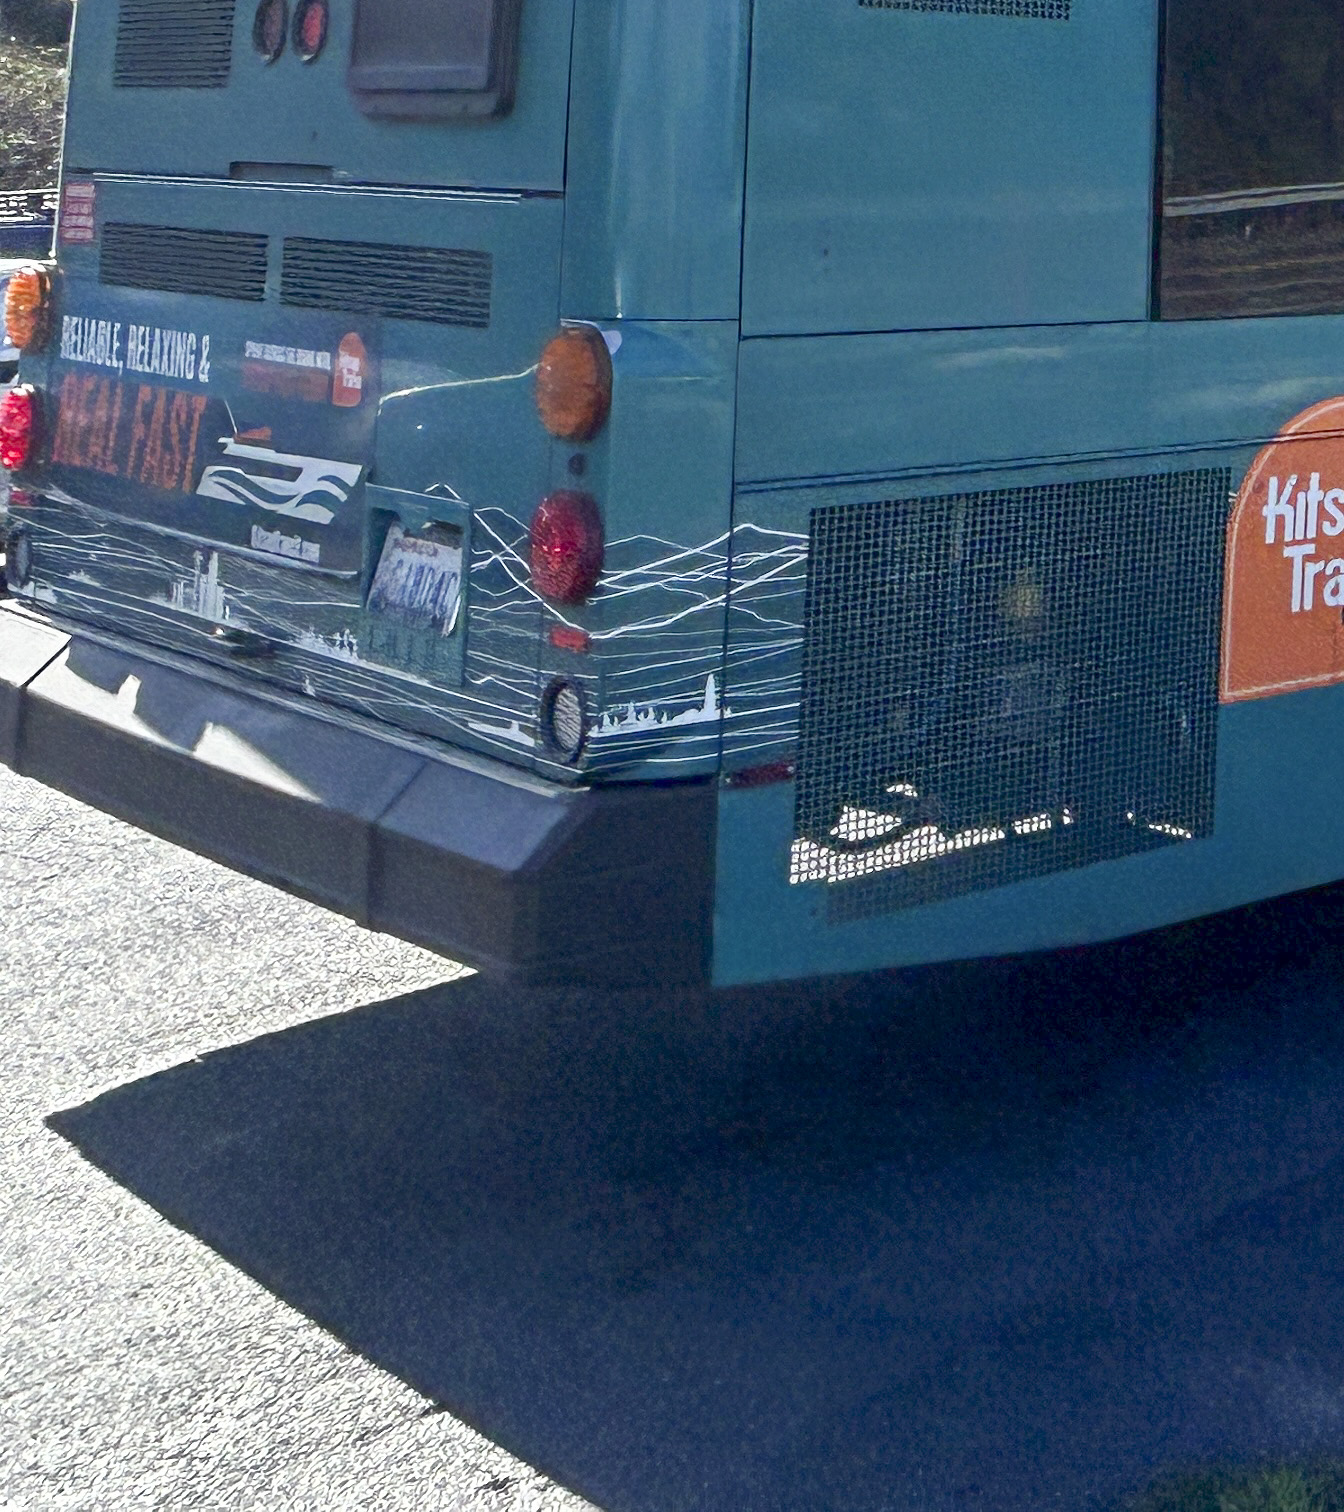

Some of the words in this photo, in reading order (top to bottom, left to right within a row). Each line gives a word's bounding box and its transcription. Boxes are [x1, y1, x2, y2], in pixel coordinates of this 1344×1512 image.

[127, 324, 196, 380] RELAXING
[199, 335, 211, 382] &
[126, 383, 208, 495] FAST
